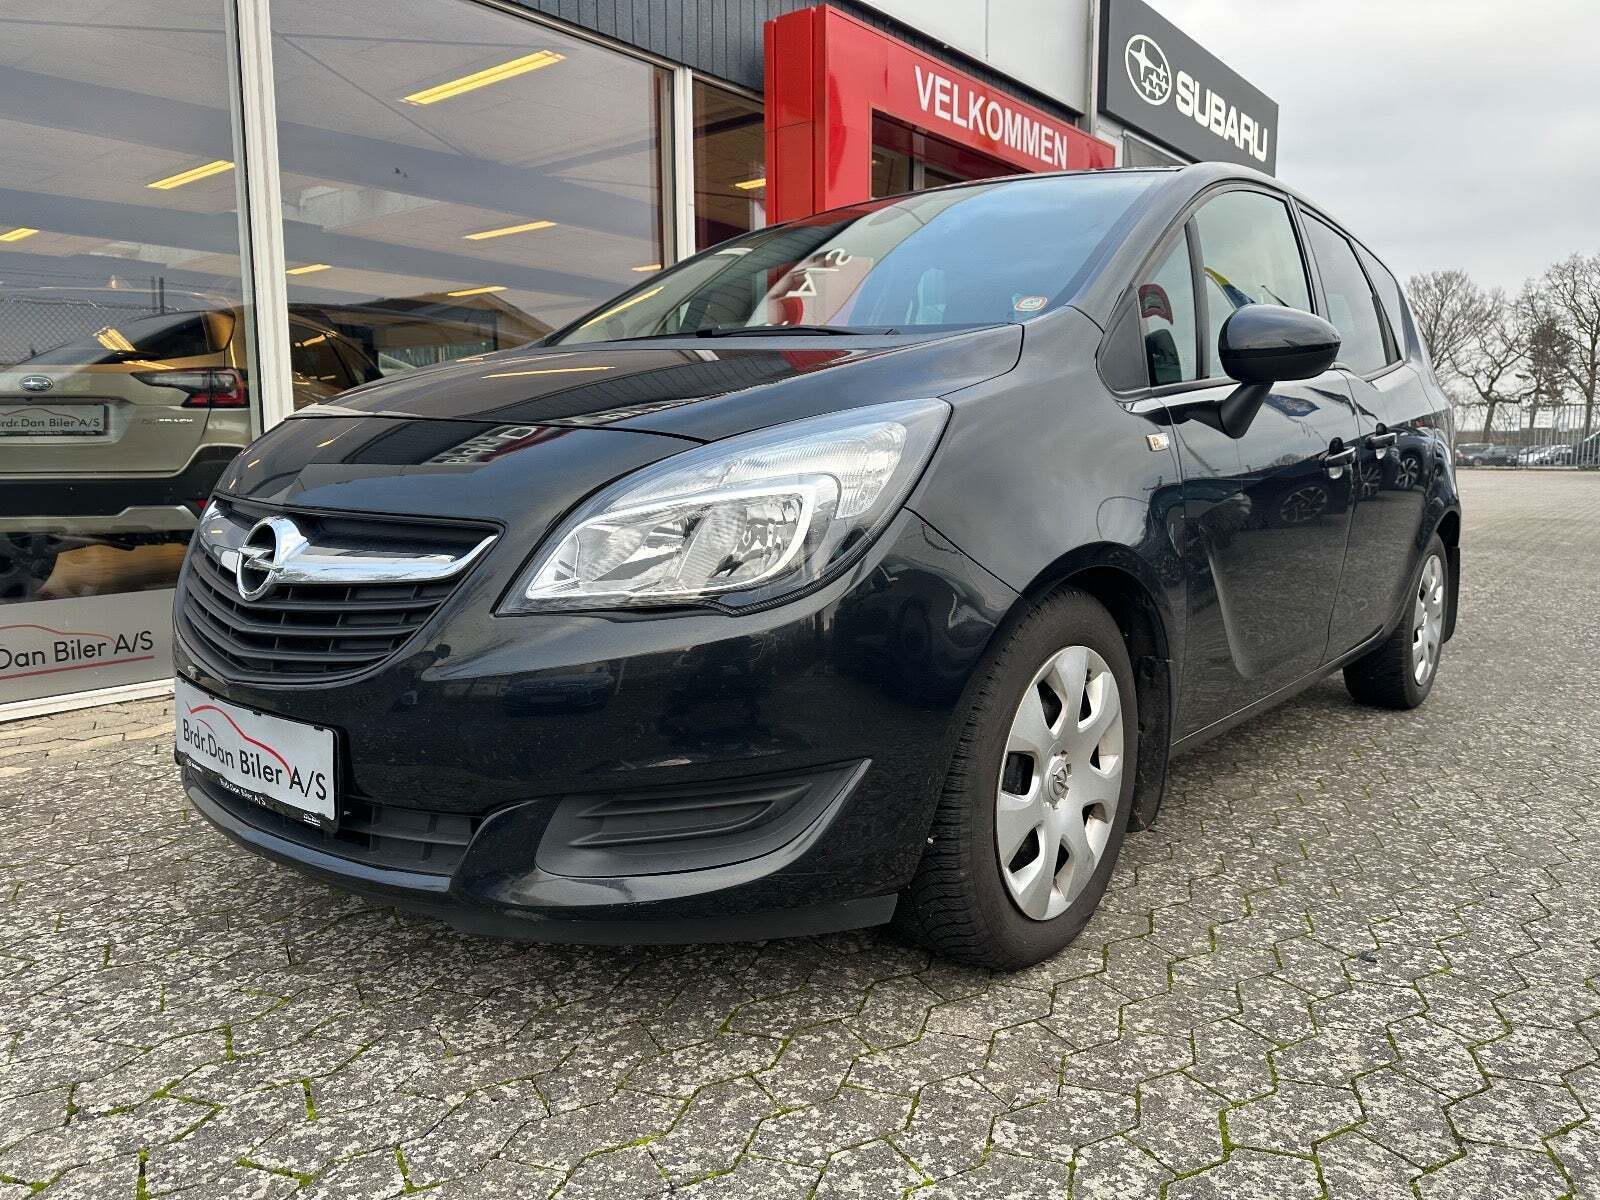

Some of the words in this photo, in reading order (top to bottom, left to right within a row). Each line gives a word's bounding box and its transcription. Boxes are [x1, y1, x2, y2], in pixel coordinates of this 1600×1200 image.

[914, 64, 1068, 170] VELKOMMEN
[1176, 70, 1269, 162] SUBARU
[49, 418, 75, 428] Biler
[79, 417, 100, 428] A/S
[53, 639, 107, 662] Biler
[114, 630, 154, 655] A/S
[182, 718, 235, 769] Brdr.Dan
[239, 748, 283, 786] Biler
[288, 765, 327, 801] A/S
